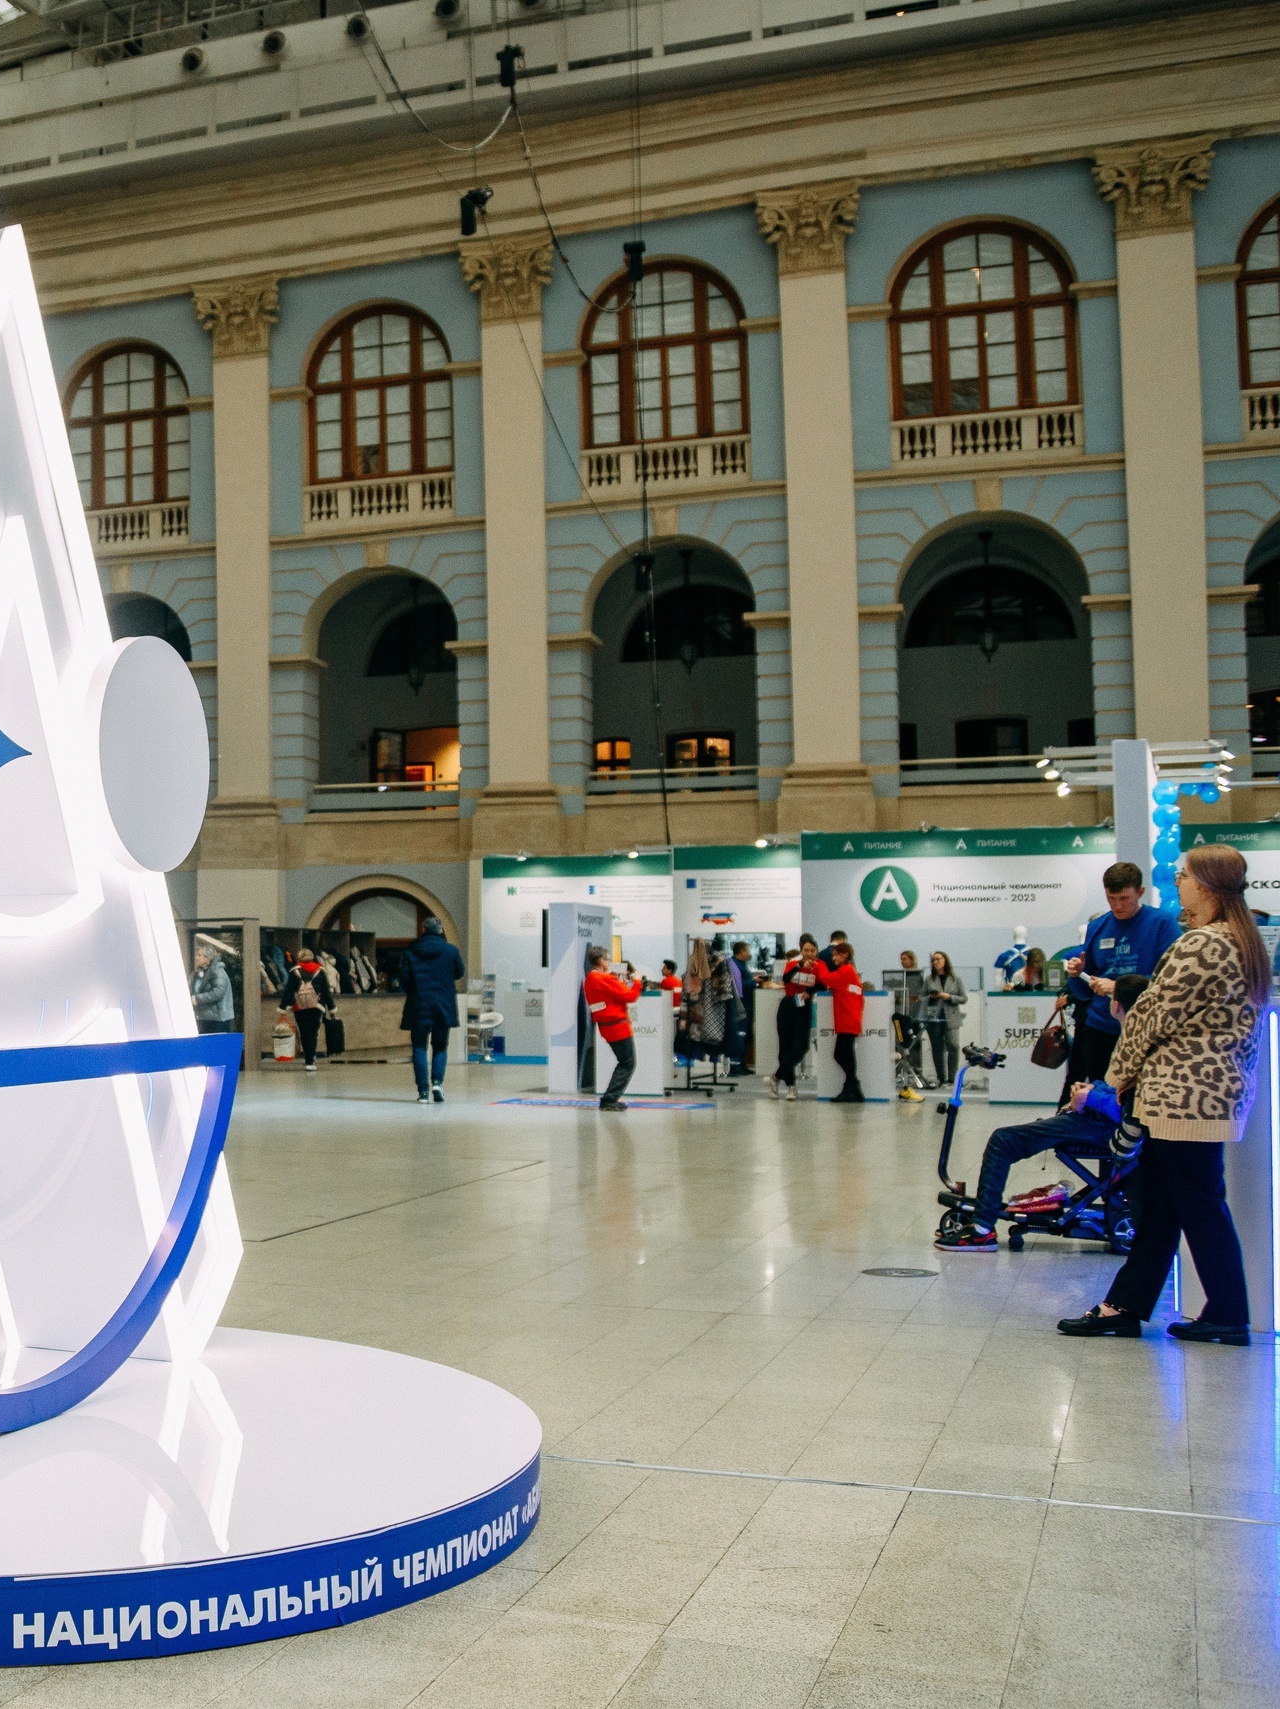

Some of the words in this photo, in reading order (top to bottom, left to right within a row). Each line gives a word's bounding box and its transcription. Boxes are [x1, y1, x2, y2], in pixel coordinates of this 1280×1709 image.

[864, 841, 902, 850] ПИТАНИЕ
[977, 839, 1017, 847] ПИТАНИЕ
[932, 882, 1007, 891] Национальный
[1009, 882, 1063, 890] чемпионат
[930, 894, 1001, 903] «Абилимпикс»
[1011, 893, 1036, 902] 2023
[13, 1556, 383, 1650] НАЦИОНАЛЬНЫЙ
[393, 1504, 519, 1588] ЧЕМПИОНАТ
